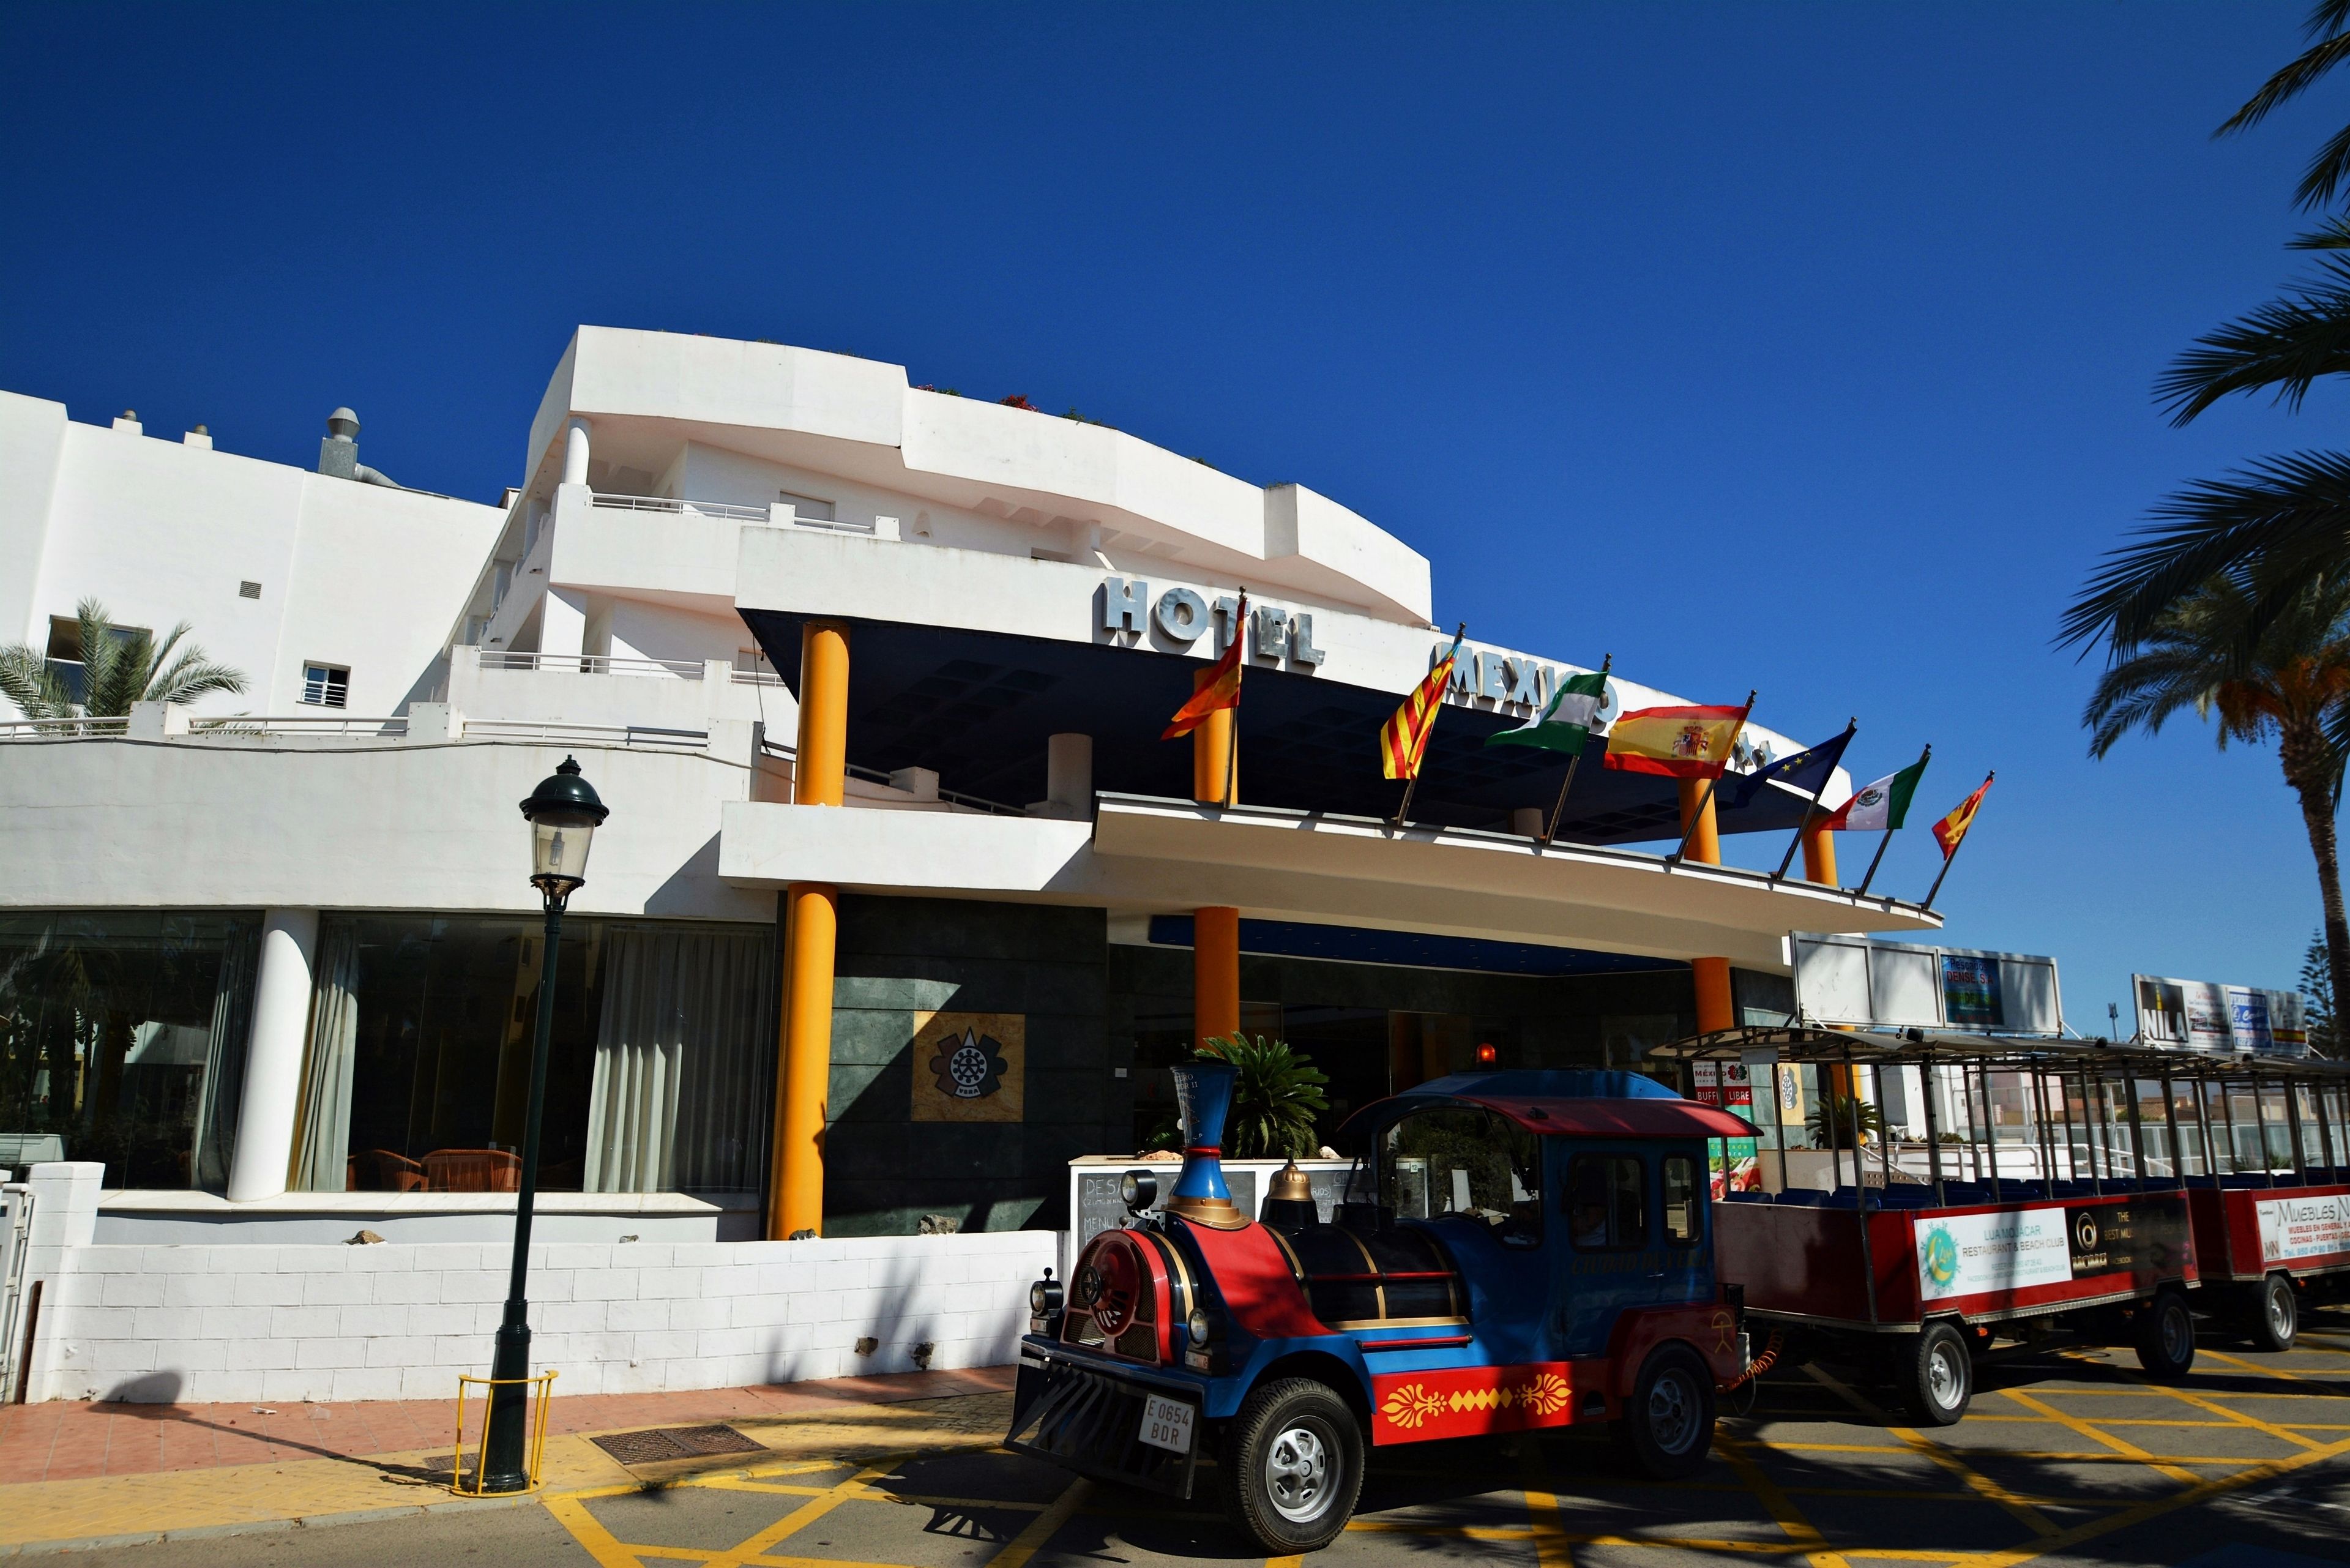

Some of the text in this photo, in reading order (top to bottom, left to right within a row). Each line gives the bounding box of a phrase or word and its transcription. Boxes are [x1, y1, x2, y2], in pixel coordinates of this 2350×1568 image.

[1103, 577, 1326, 667] HOTEL
[1436, 641, 1618, 723] MEXIO
[1950, 958, 1988, 971] Pescados
[1698, 1091, 1750, 1100] BUFF LIBRE
[2117, 1211, 2130, 1223] THE
[1983, 1228, 2001, 1241] LUA
[2104, 1228, 2119, 1241] BEST
[1962, 1237, 2065, 1258] RESTAURANT & BEACH CLUB
[1147, 1400, 1189, 1427] E 0654
[1151, 1422, 1179, 1445] BDR
